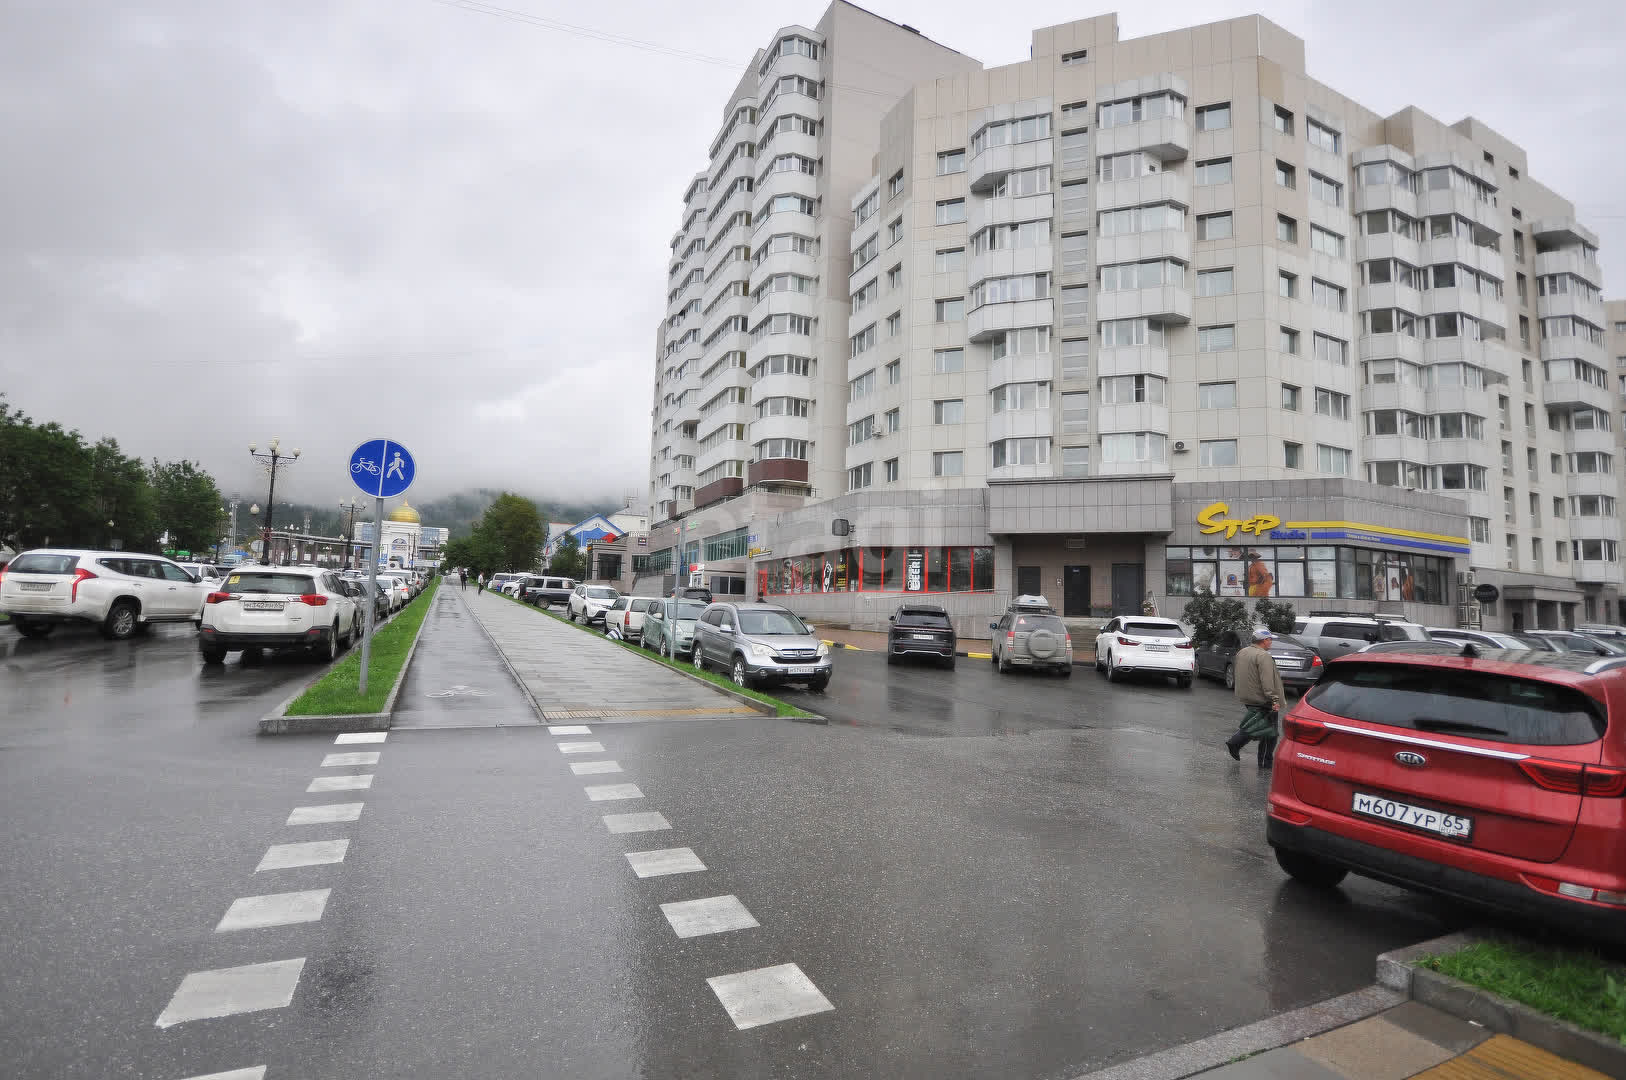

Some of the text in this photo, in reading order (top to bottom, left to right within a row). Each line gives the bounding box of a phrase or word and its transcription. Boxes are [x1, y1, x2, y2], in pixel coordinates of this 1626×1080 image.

[1296, 752, 1336, 766] SPORTAGE
[1399, 753, 1420, 764] KIA
[1443, 815, 1464, 831] 65
